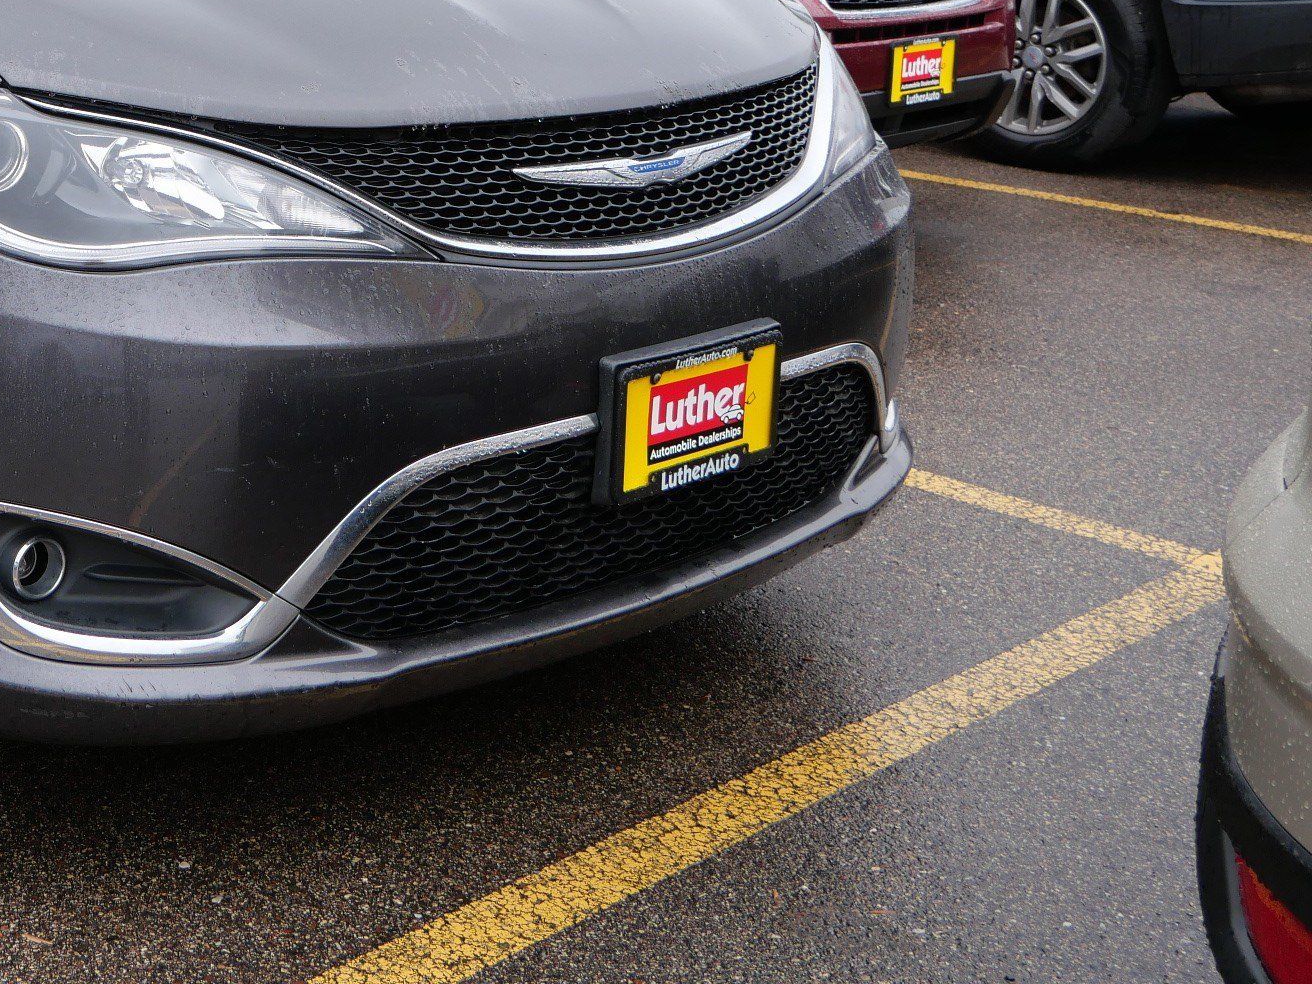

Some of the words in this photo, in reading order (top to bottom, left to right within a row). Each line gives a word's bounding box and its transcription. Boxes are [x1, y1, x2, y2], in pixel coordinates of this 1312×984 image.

[902, 54, 941, 78] Luther
[633, 159, 680, 172] CHRYSLER
[675, 346, 738, 370] LutherAuto.com
[650, 382, 746, 436] Luther
[649, 439, 697, 461] Automobile
[698, 425, 742, 446] Dealerships
[661, 452, 740, 491] LutherAuto
